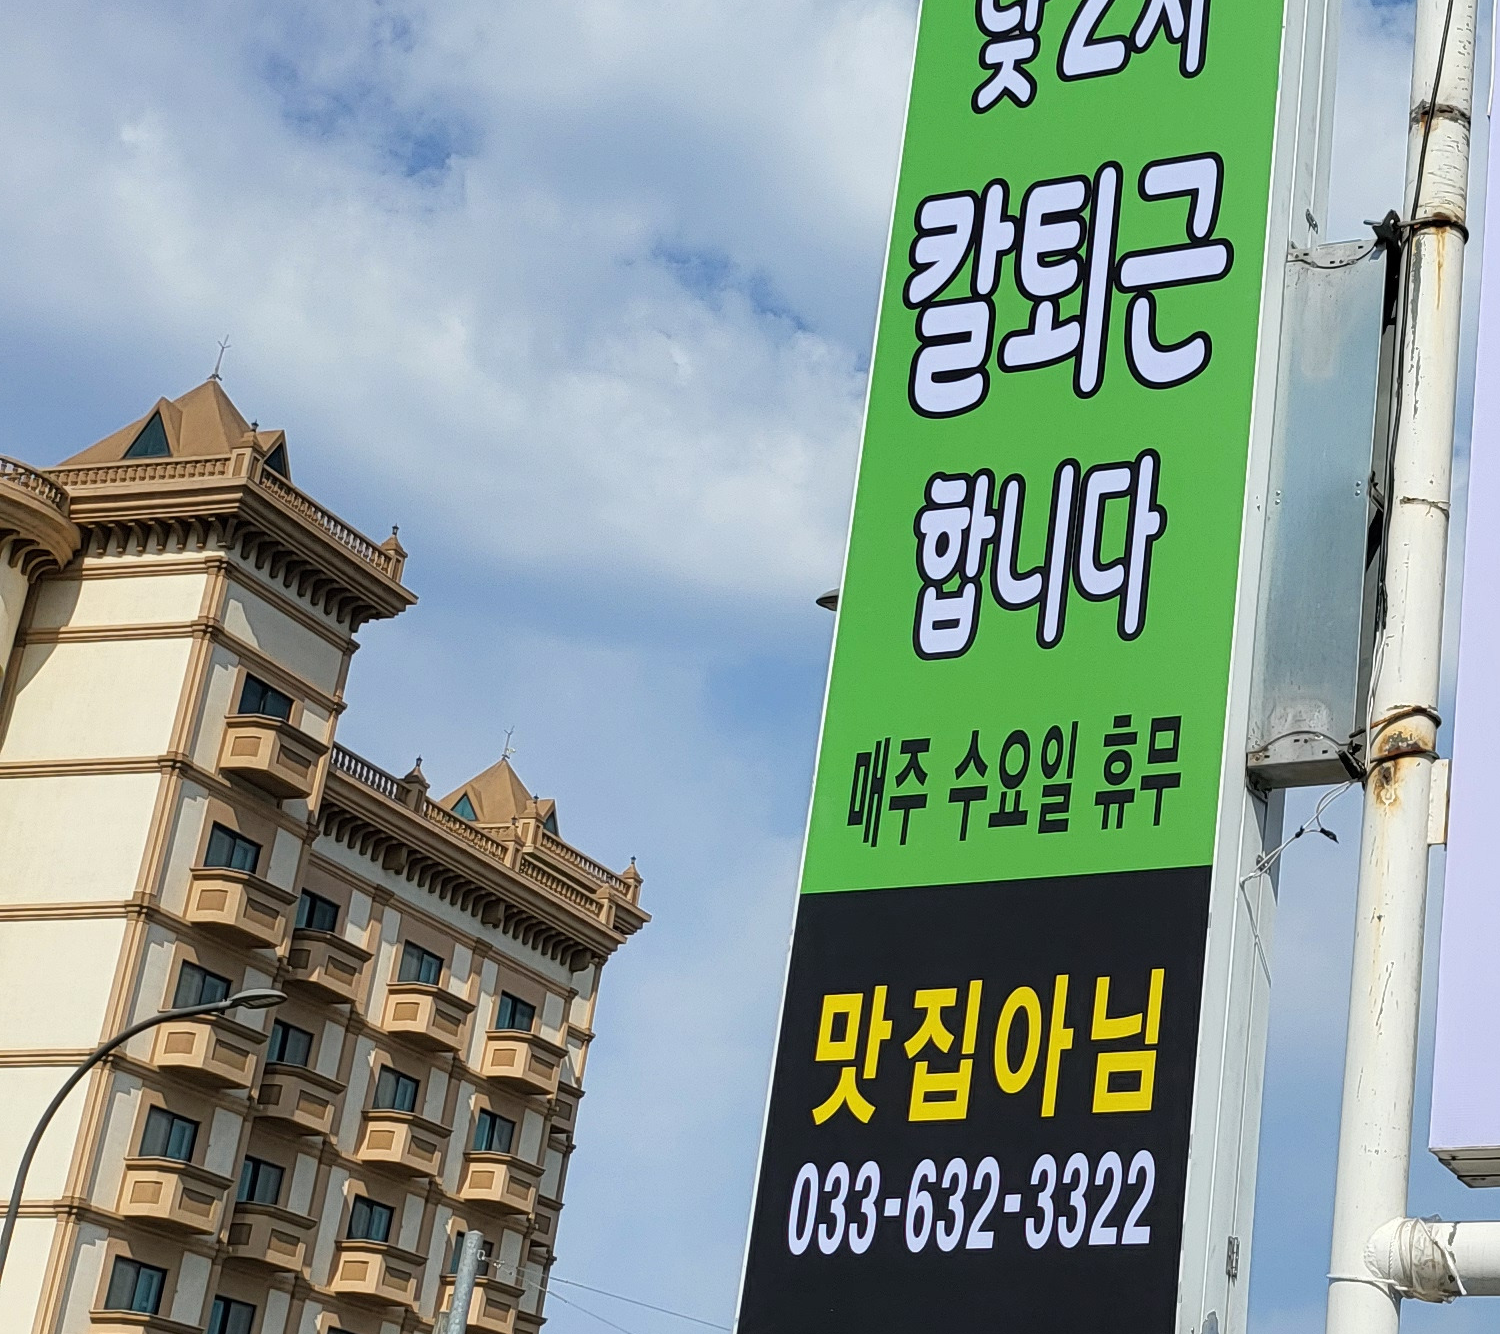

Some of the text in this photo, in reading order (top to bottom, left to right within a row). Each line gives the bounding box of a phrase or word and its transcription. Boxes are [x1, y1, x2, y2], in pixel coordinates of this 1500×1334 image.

[902, 151, 1234, 420] 칼퇴근
[912, 448, 1168, 661] 합니다
[848, 714, 1183, 848] 매주 수요일 휴무
[811, 968, 1166, 1126] 맛집아님
[787, 1149, 1156, 1257] 033-632-3322
